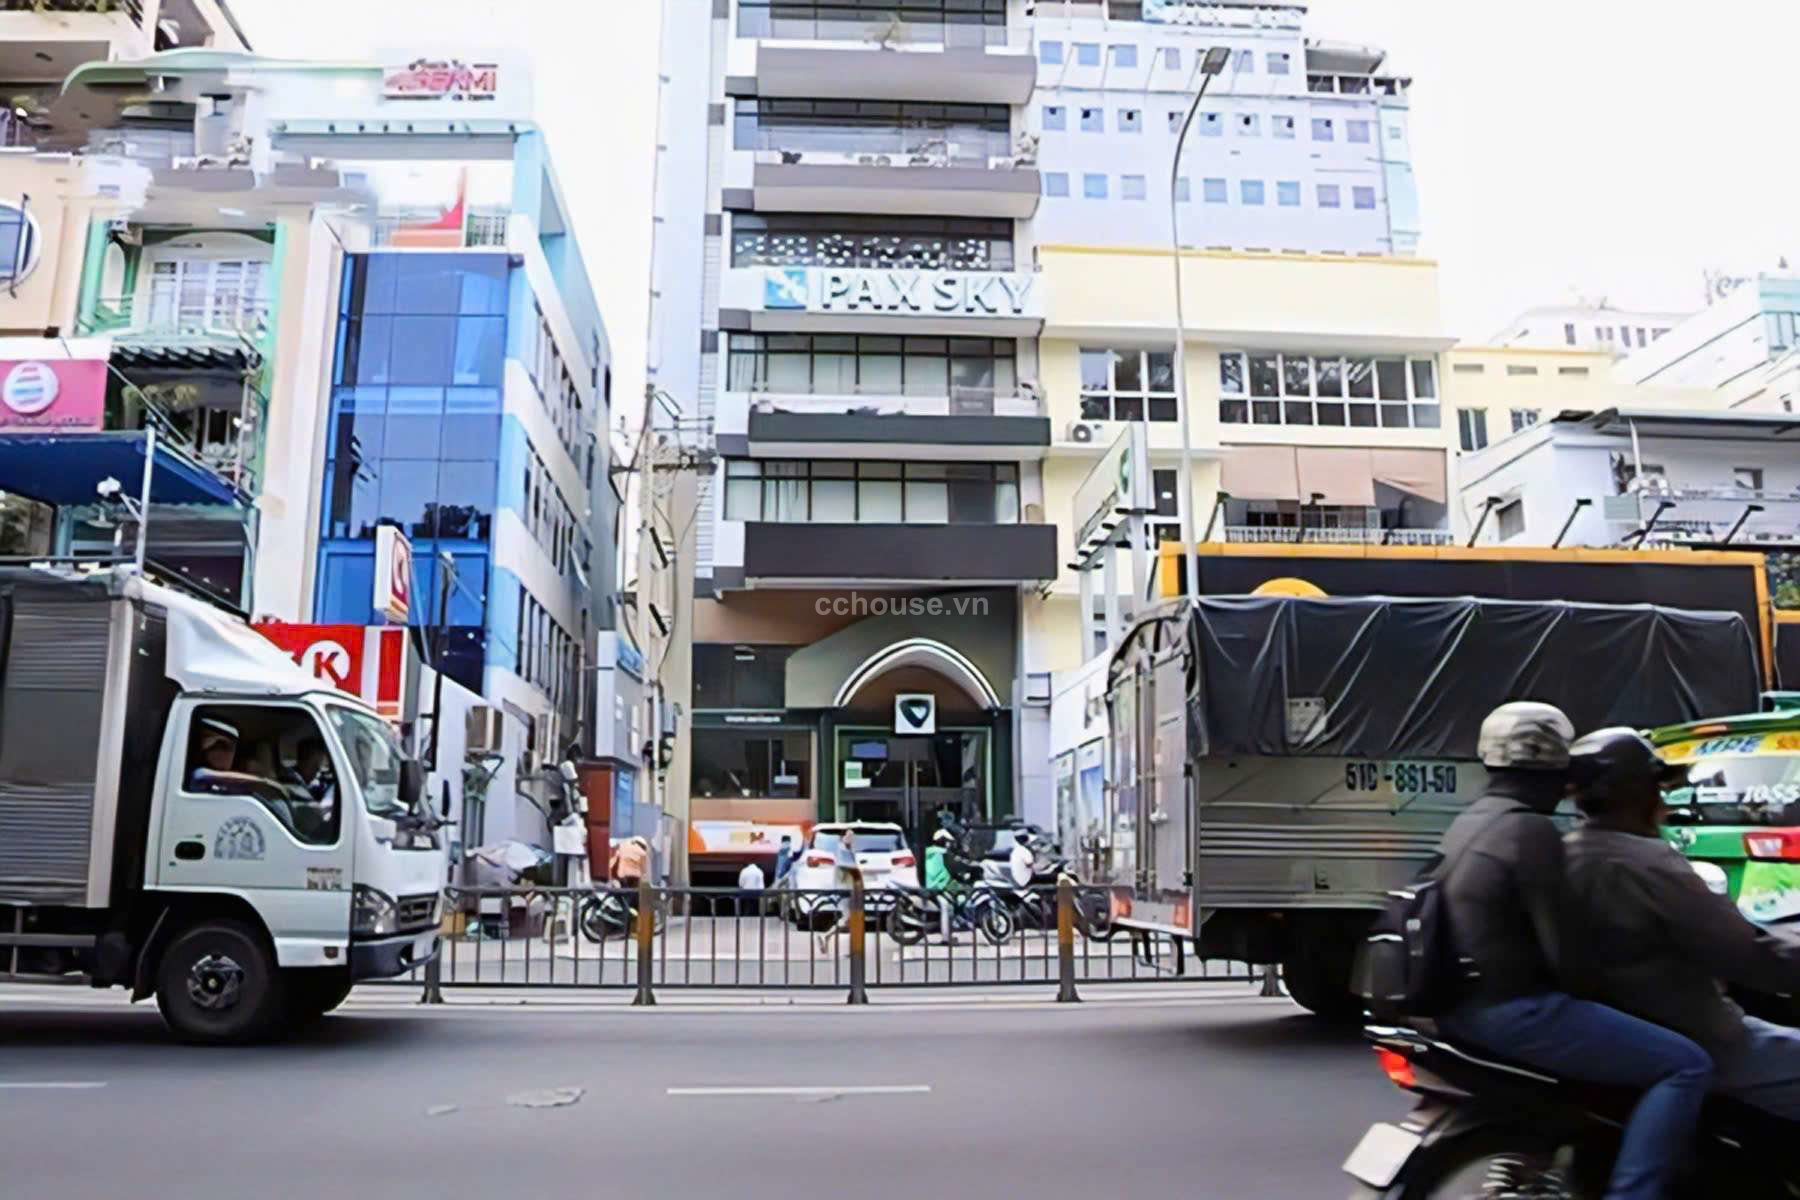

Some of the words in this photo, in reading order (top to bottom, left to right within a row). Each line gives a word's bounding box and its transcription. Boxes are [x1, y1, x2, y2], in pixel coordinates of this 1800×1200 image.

[822, 272, 921, 311] PAX
[933, 274, 1034, 314] SKY
[313, 651, 342, 688] K
